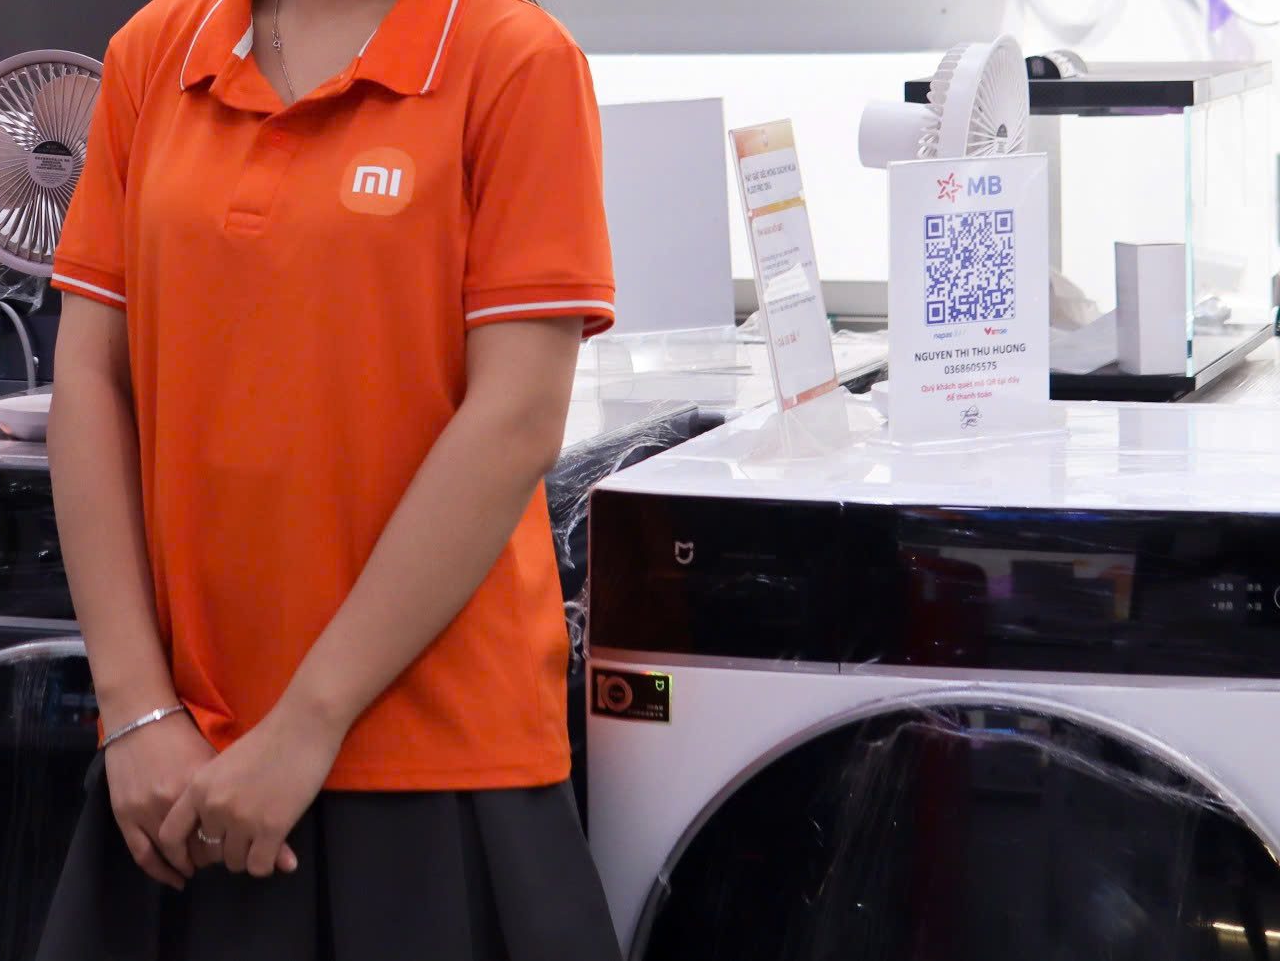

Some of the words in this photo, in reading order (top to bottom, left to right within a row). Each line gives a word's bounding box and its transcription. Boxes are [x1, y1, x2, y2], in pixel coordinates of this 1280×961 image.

[967, 175, 1003, 197] MB
[914, 351, 953, 362] NGUYEN
[955, 349, 970, 359] THI
[972, 347, 991, 356] THU
[993, 343, 1026, 354] HUONG
